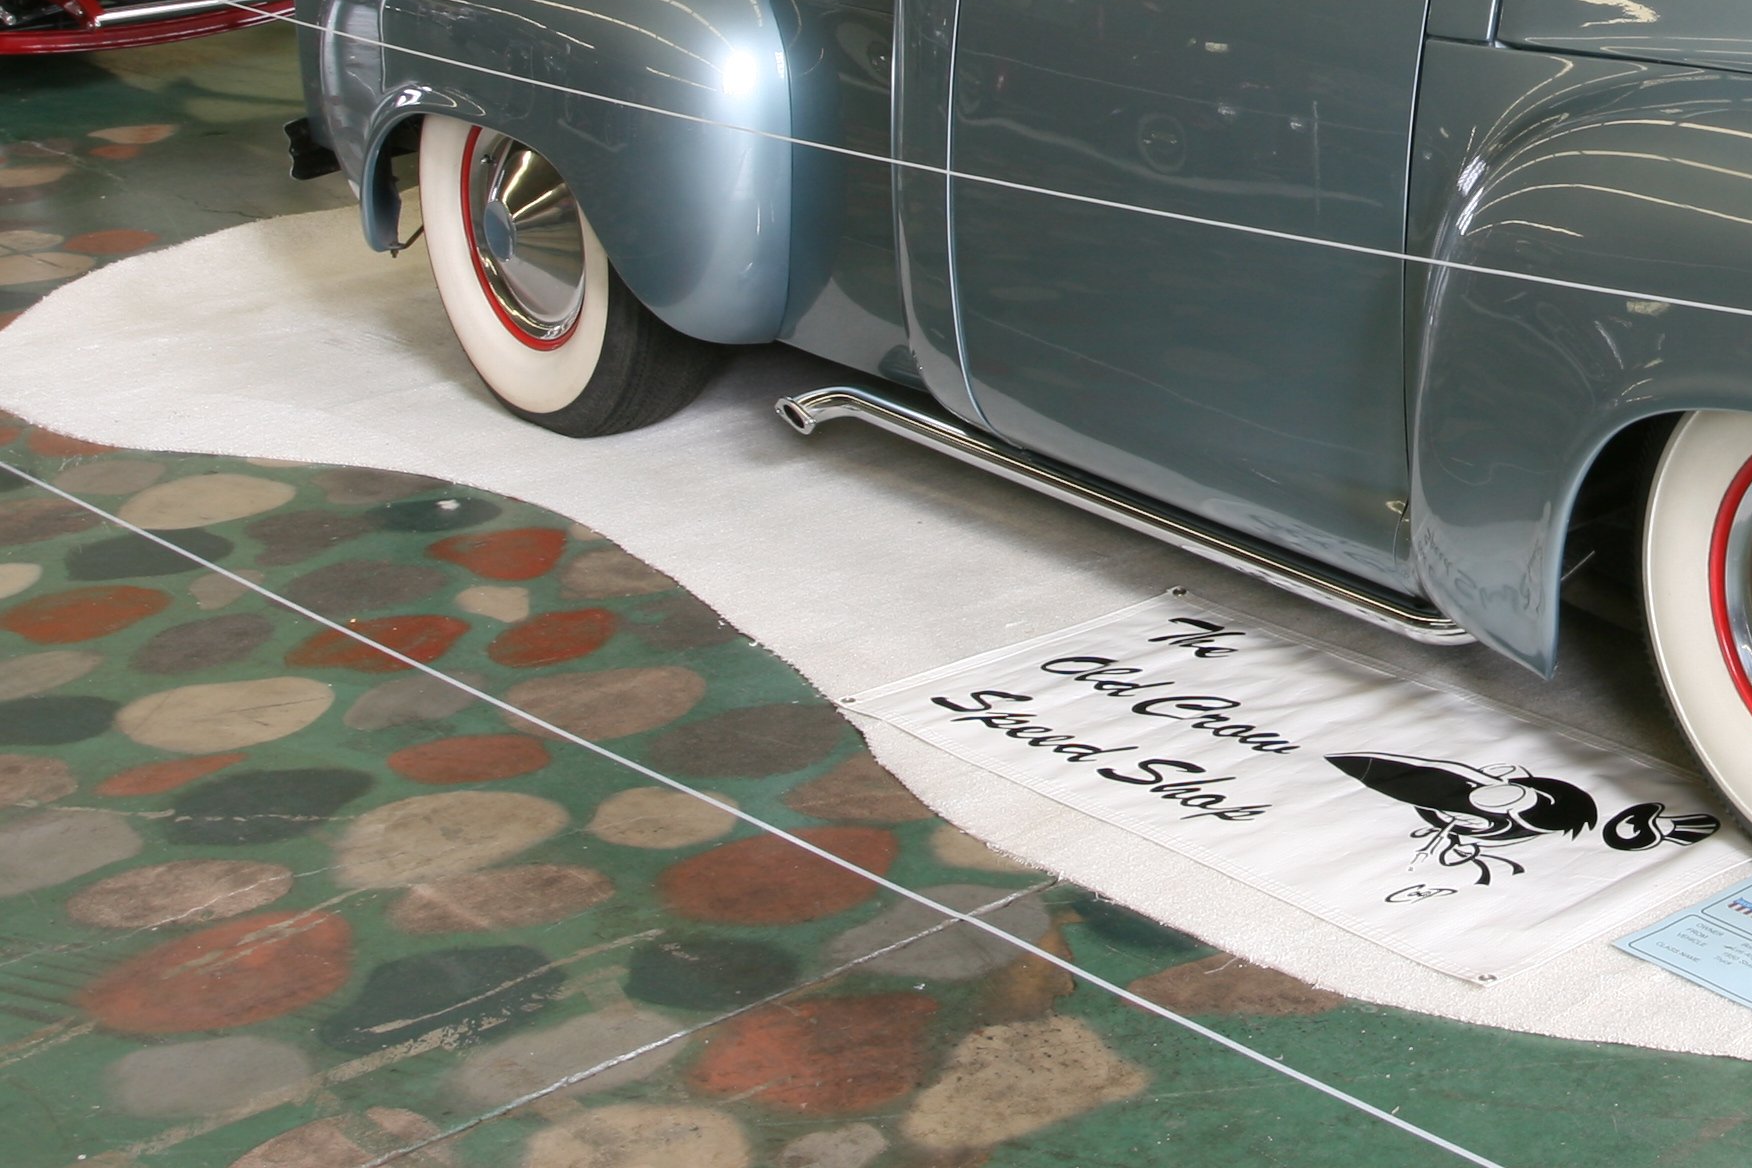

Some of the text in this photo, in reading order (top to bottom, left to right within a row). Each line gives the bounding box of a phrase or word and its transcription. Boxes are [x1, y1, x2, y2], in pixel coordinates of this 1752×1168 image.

[1148, 617, 1246, 658] The
[1041, 656, 1301, 754] Old Crow
[931, 690, 1272, 821] Speed Shop
